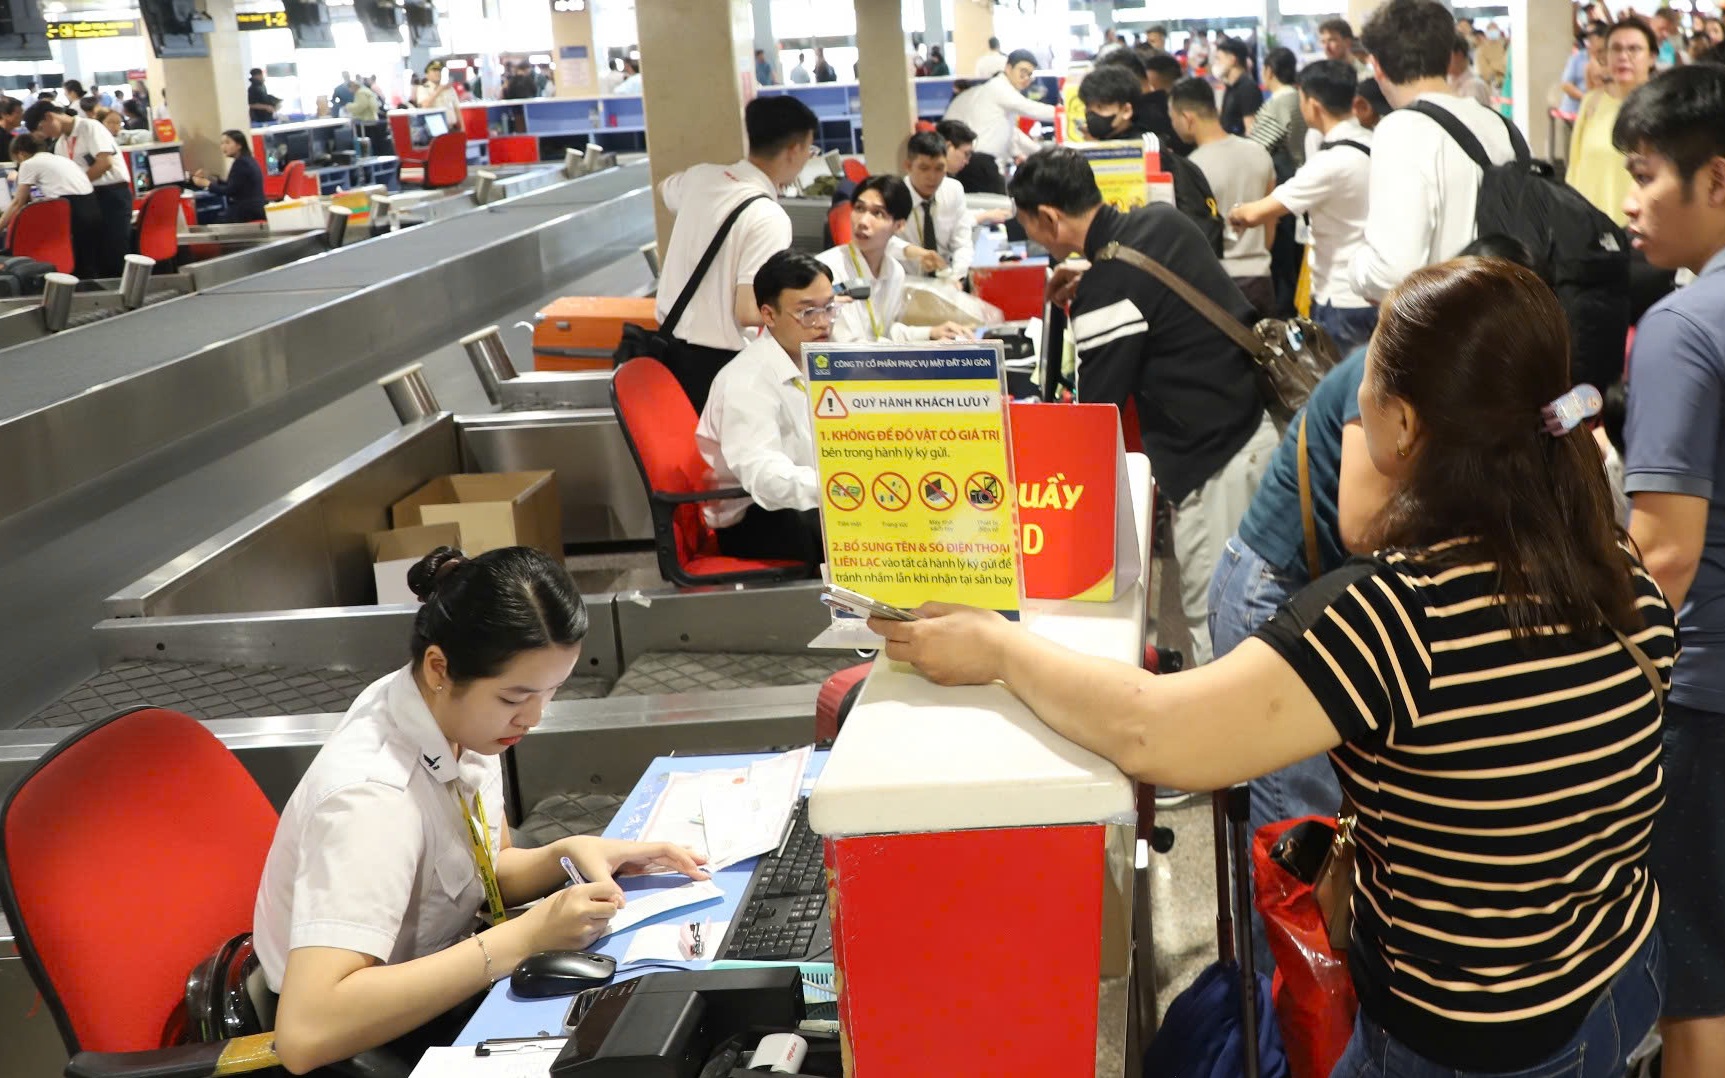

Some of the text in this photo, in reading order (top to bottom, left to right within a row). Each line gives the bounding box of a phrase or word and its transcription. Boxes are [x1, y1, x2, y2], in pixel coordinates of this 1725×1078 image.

[834, 359, 855, 368] CÔNG
[855, 360, 865, 368] TY
[865, 358, 876, 368] CỔ
[898, 359, 918, 369] PHỤC
[918, 359, 929, 369] VỤ
[961, 358, 973, 367] SÀI
[974, 358, 991, 367] GÒN
[852, 396, 990, 408] QUÝ HÀNH KHÁCH LƯU Ý
[821, 426, 1000, 443] 1. KHÔNG ĐỂ ĐỒ VẬT CÓ GIÁ TRỊ
[821, 447, 843, 458] bên
[844, 447, 873, 461] trong
[875, 446, 902, 458] hành
[904, 446, 914, 460] lý
[916, 446, 927, 460] ký
[833, 540, 1010, 556] 2. BỔ SUNG TÊN & SỐ ĐIỆN THOẠI
[834, 556, 858, 567] LIÊN
[859, 558, 881, 569] LẠC
[882, 558, 900, 568] vào
[902, 557, 915, 568] tất
[916, 558, 928, 568] cả
[930, 558, 956, 568] hành
[957, 558, 966, 571] lý
[967, 558, 979, 571] ký
[998, 558, 1012, 569] để
[836, 572, 1013, 586] tránh nhầm lẫn khi nhận tại sân bay
